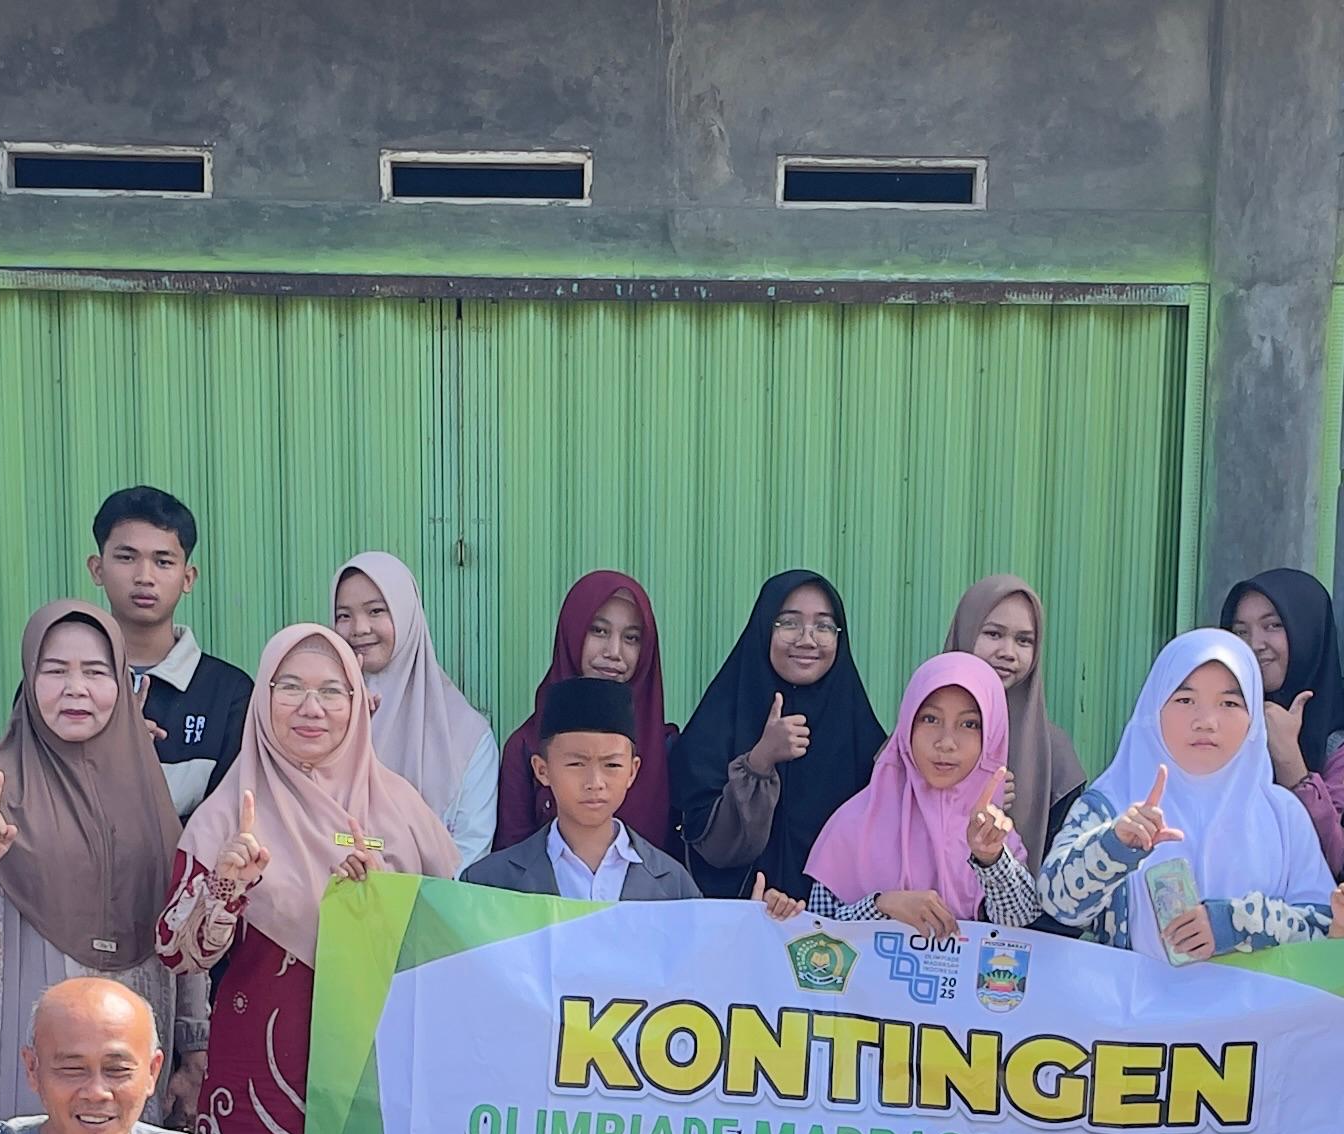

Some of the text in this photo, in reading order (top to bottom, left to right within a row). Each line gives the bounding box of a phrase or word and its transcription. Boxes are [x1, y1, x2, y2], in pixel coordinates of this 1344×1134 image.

[941, 976, 957, 988] 20
[939, 988, 955, 999] 25
[553, 996, 1259, 1130] KONTINGEN
